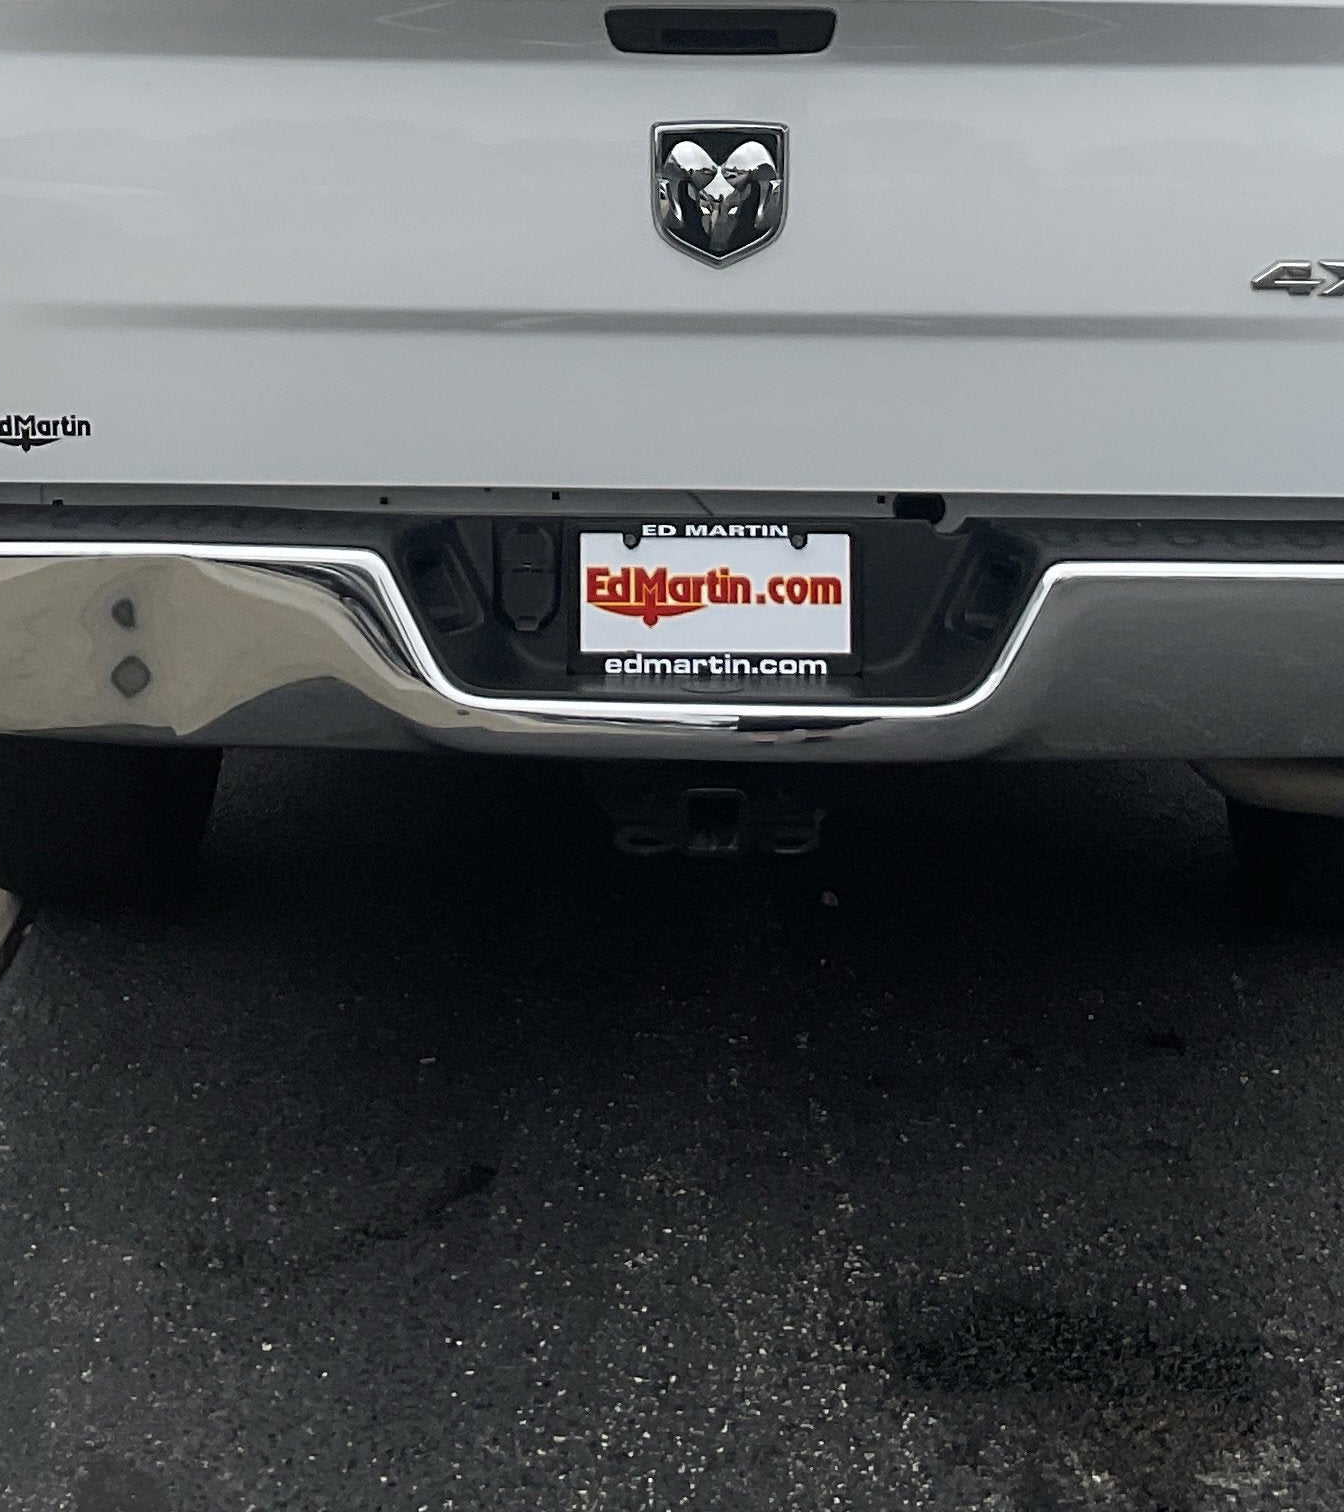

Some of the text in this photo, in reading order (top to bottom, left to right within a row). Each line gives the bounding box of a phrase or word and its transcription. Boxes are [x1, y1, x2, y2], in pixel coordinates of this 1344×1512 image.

[642, 524, 789, 537] ED MARTIN
[586, 567, 842, 615] EdMartin.com
[604, 654, 828, 675] edmartin.com
